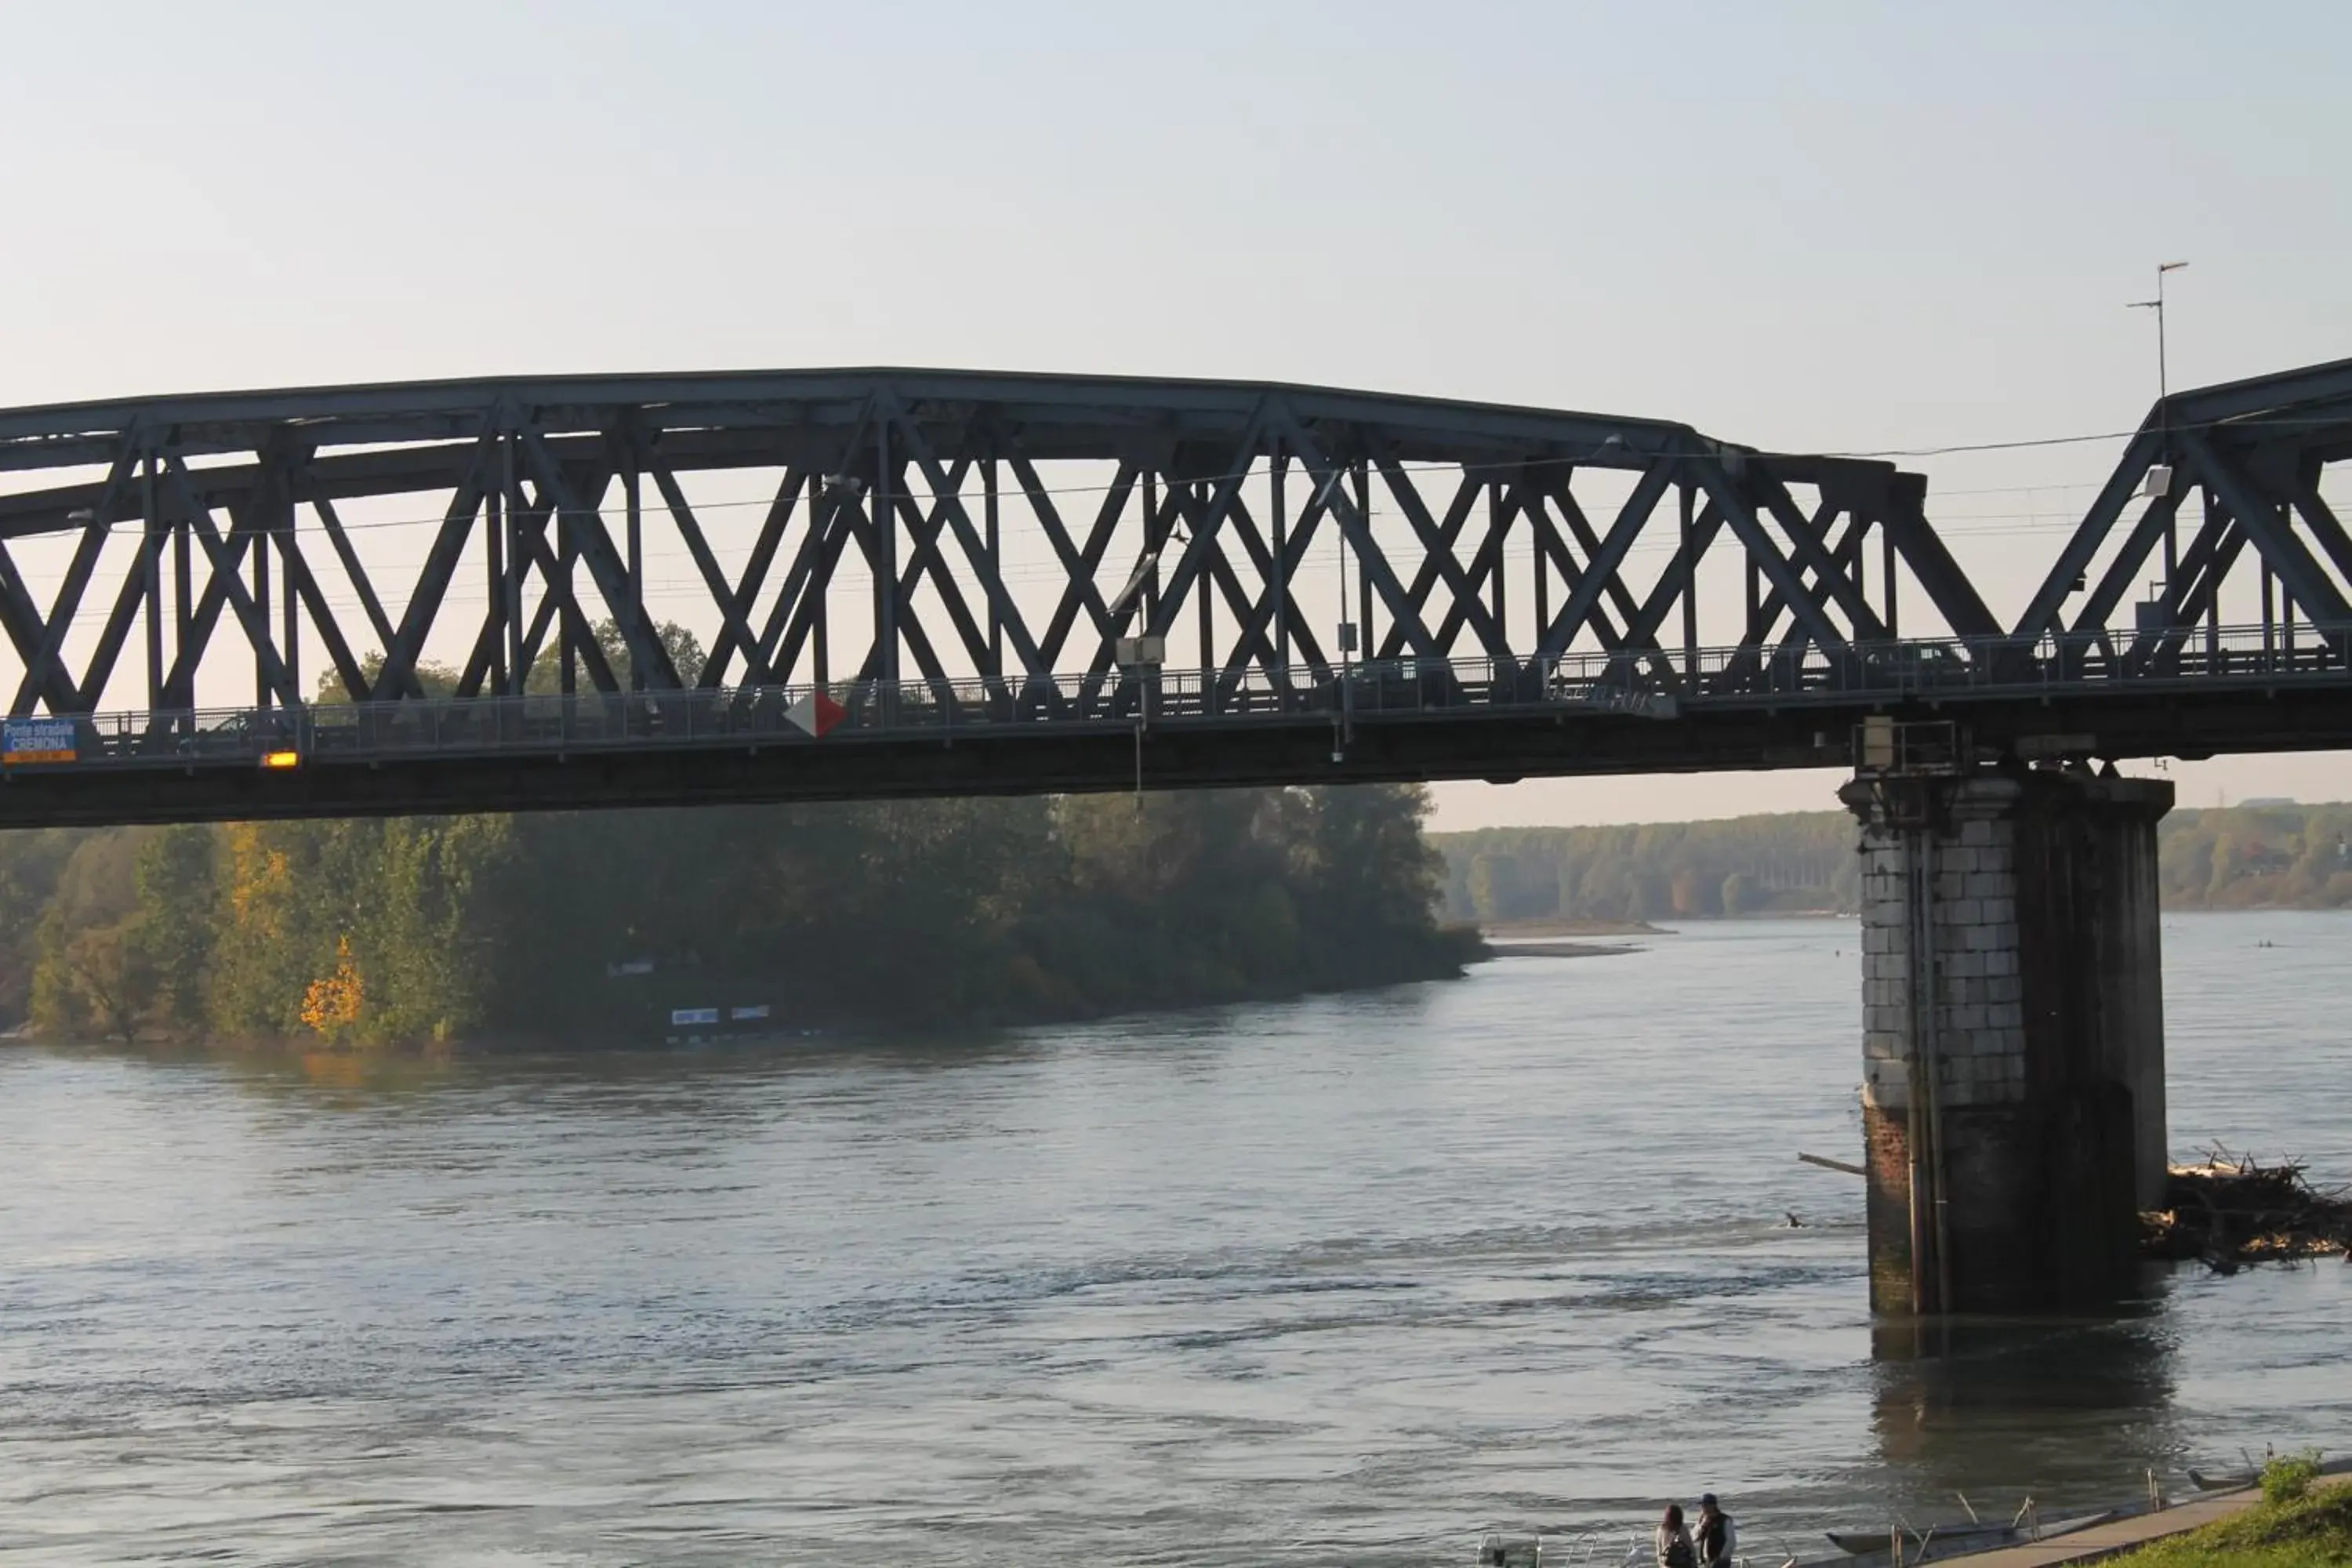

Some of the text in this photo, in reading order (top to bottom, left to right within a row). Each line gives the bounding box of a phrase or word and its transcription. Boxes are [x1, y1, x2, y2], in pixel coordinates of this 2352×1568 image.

[3, 721, 75, 738] Ponte stradale
[12, 736, 67, 751] CREMONA
